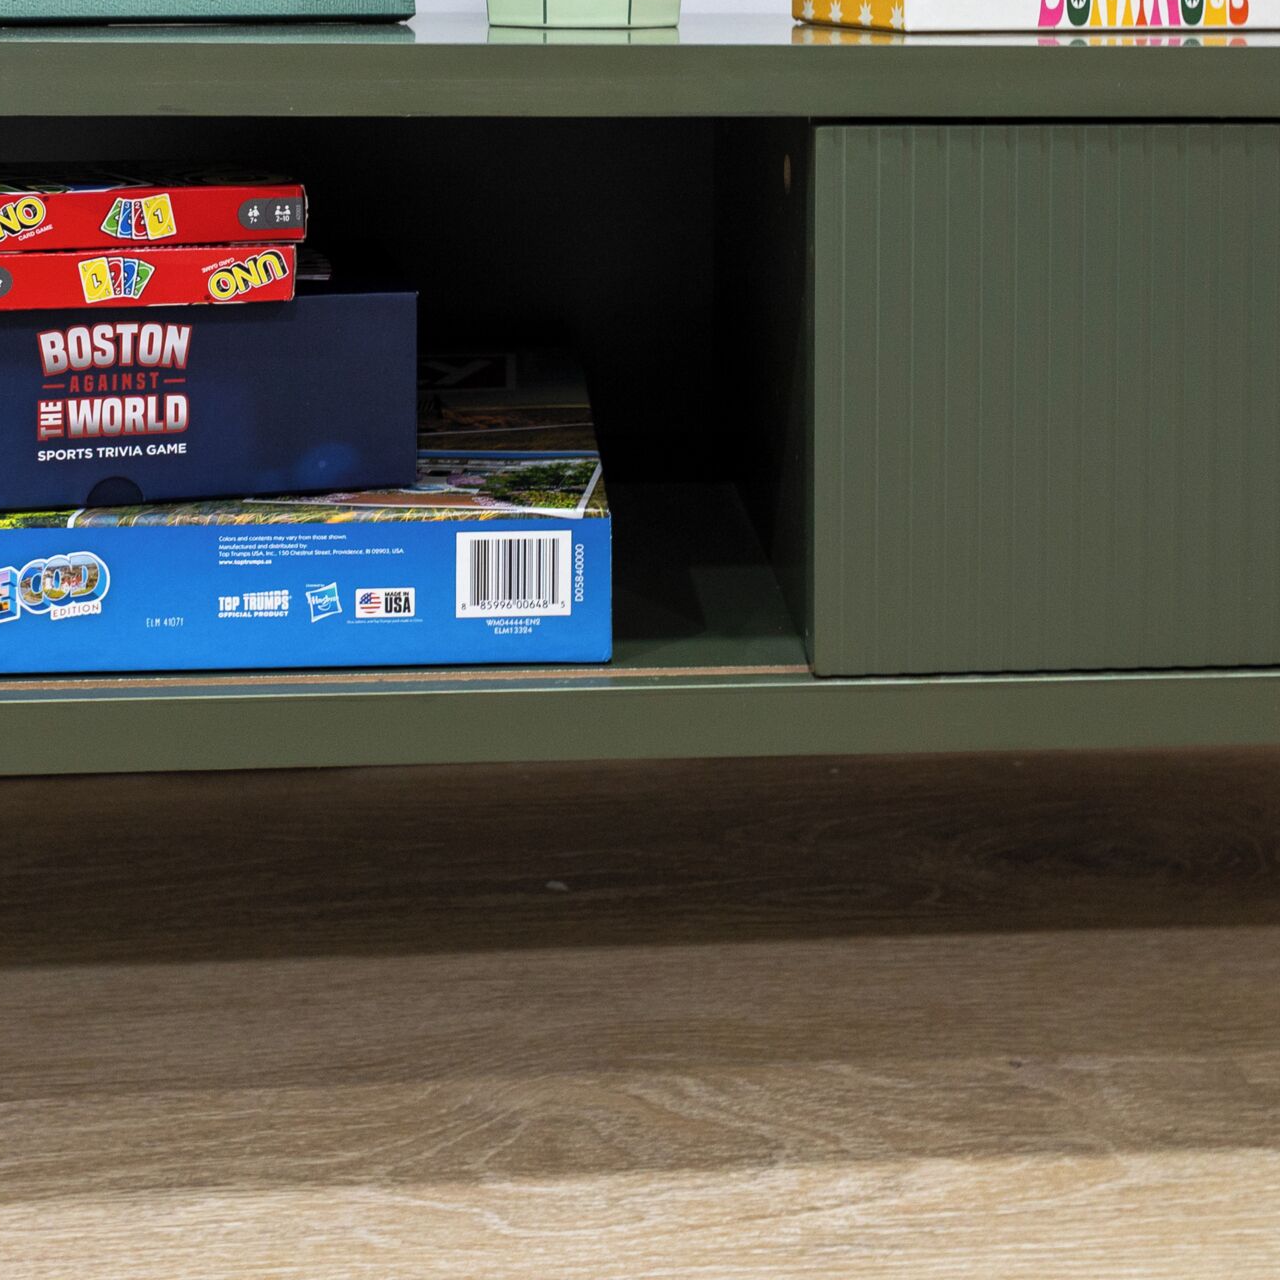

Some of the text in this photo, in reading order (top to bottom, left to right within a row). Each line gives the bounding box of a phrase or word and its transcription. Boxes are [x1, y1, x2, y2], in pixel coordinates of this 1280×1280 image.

[153, 208, 163, 223] 1
[18, 224, 53, 241] CARD GAME
[219, 257, 235, 267] CARD
[92, 273, 102, 288] 1
[208, 249, 289, 301] UNO
[36, 321, 193, 377] BOSTON
[70, 372, 160, 393] AGAINST
[37, 393, 189, 440] THE WORLD
[37, 443, 187, 462] SPORTS TRIVIA GAME
[17, 551, 110, 614] COD
[218, 589, 289, 611] TOP TRUMPS
[384, 596, 411, 614] USA
[461, 602, 466, 610] 8
[516, 600, 549, 609] 00648
[53, 604, 99, 618] EDITION
